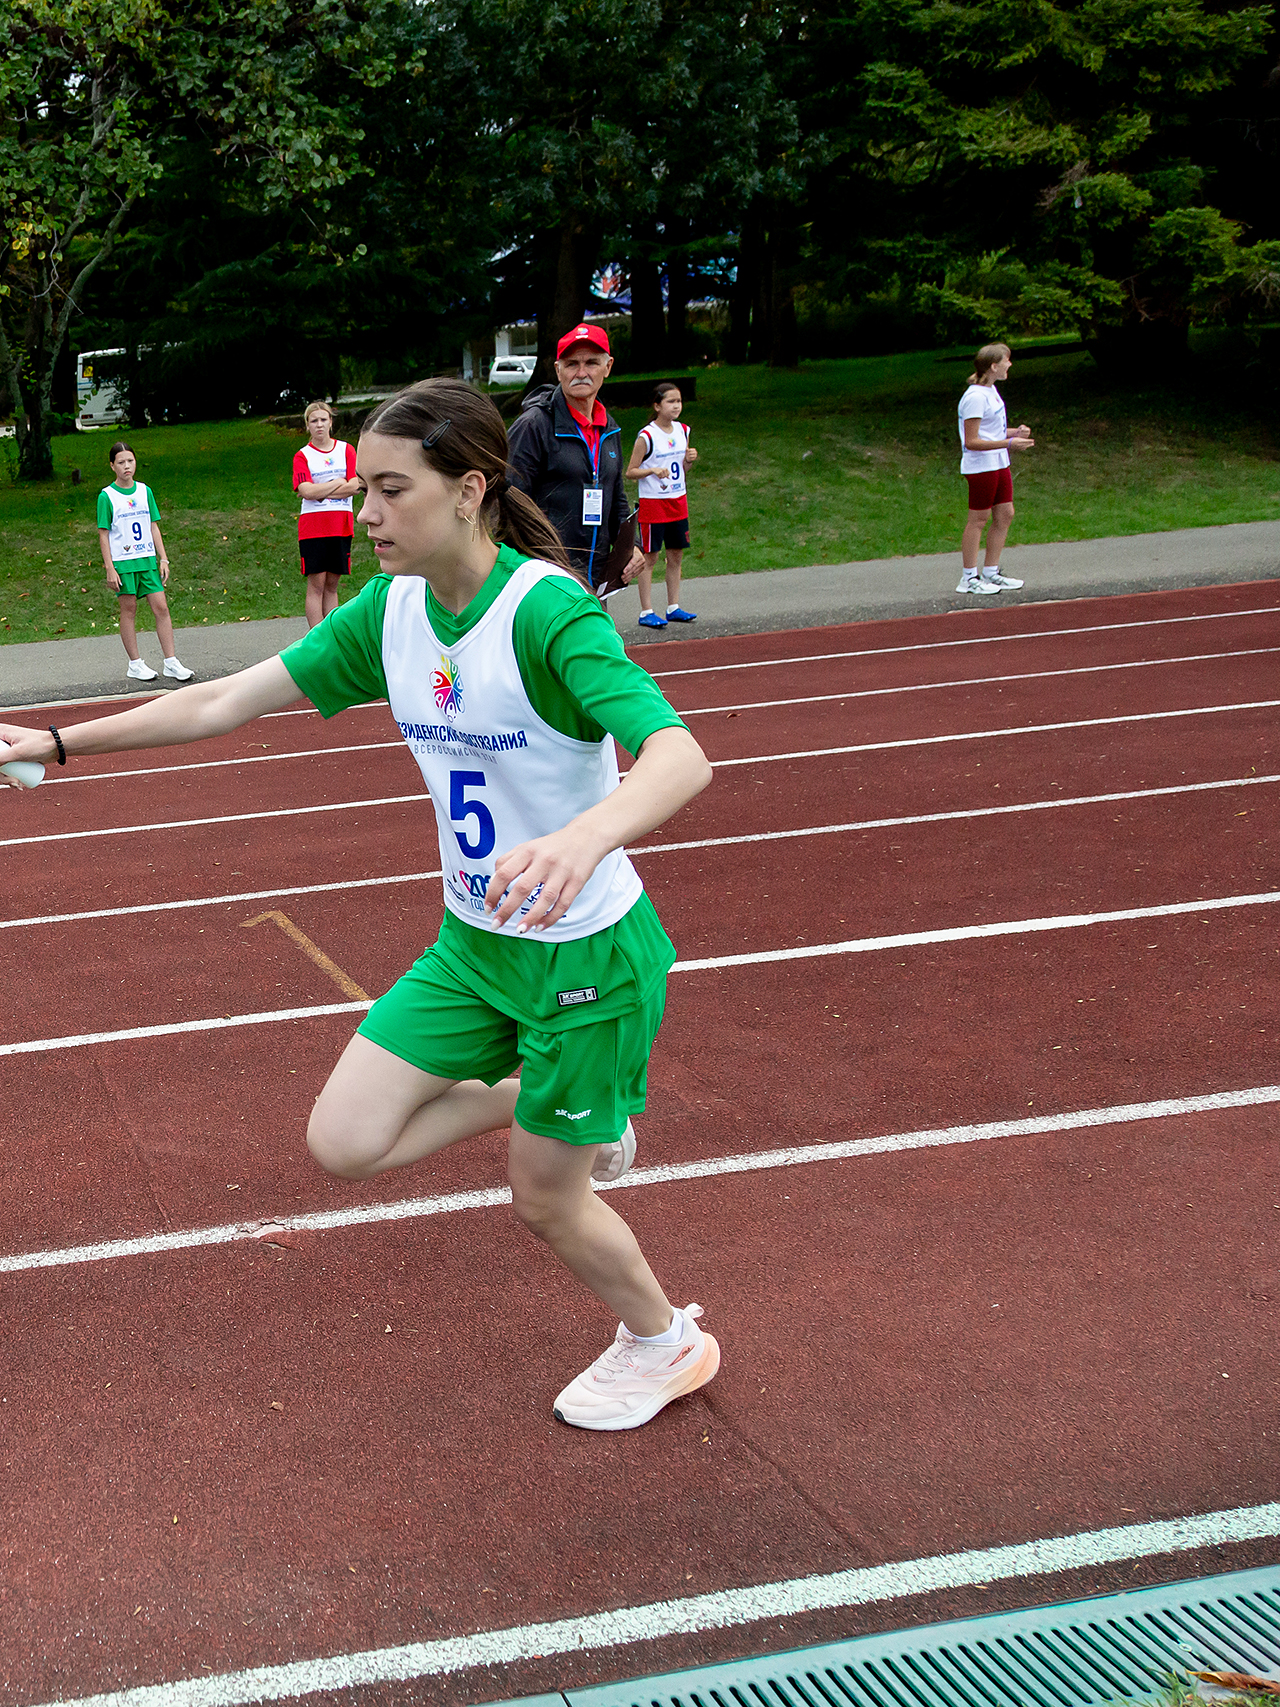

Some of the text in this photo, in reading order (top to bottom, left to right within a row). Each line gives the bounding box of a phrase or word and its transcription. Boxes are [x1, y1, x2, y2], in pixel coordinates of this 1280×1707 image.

[671, 461, 680, 480] 9
[131, 522, 142, 541] 9
[449, 770, 496, 860] 5
